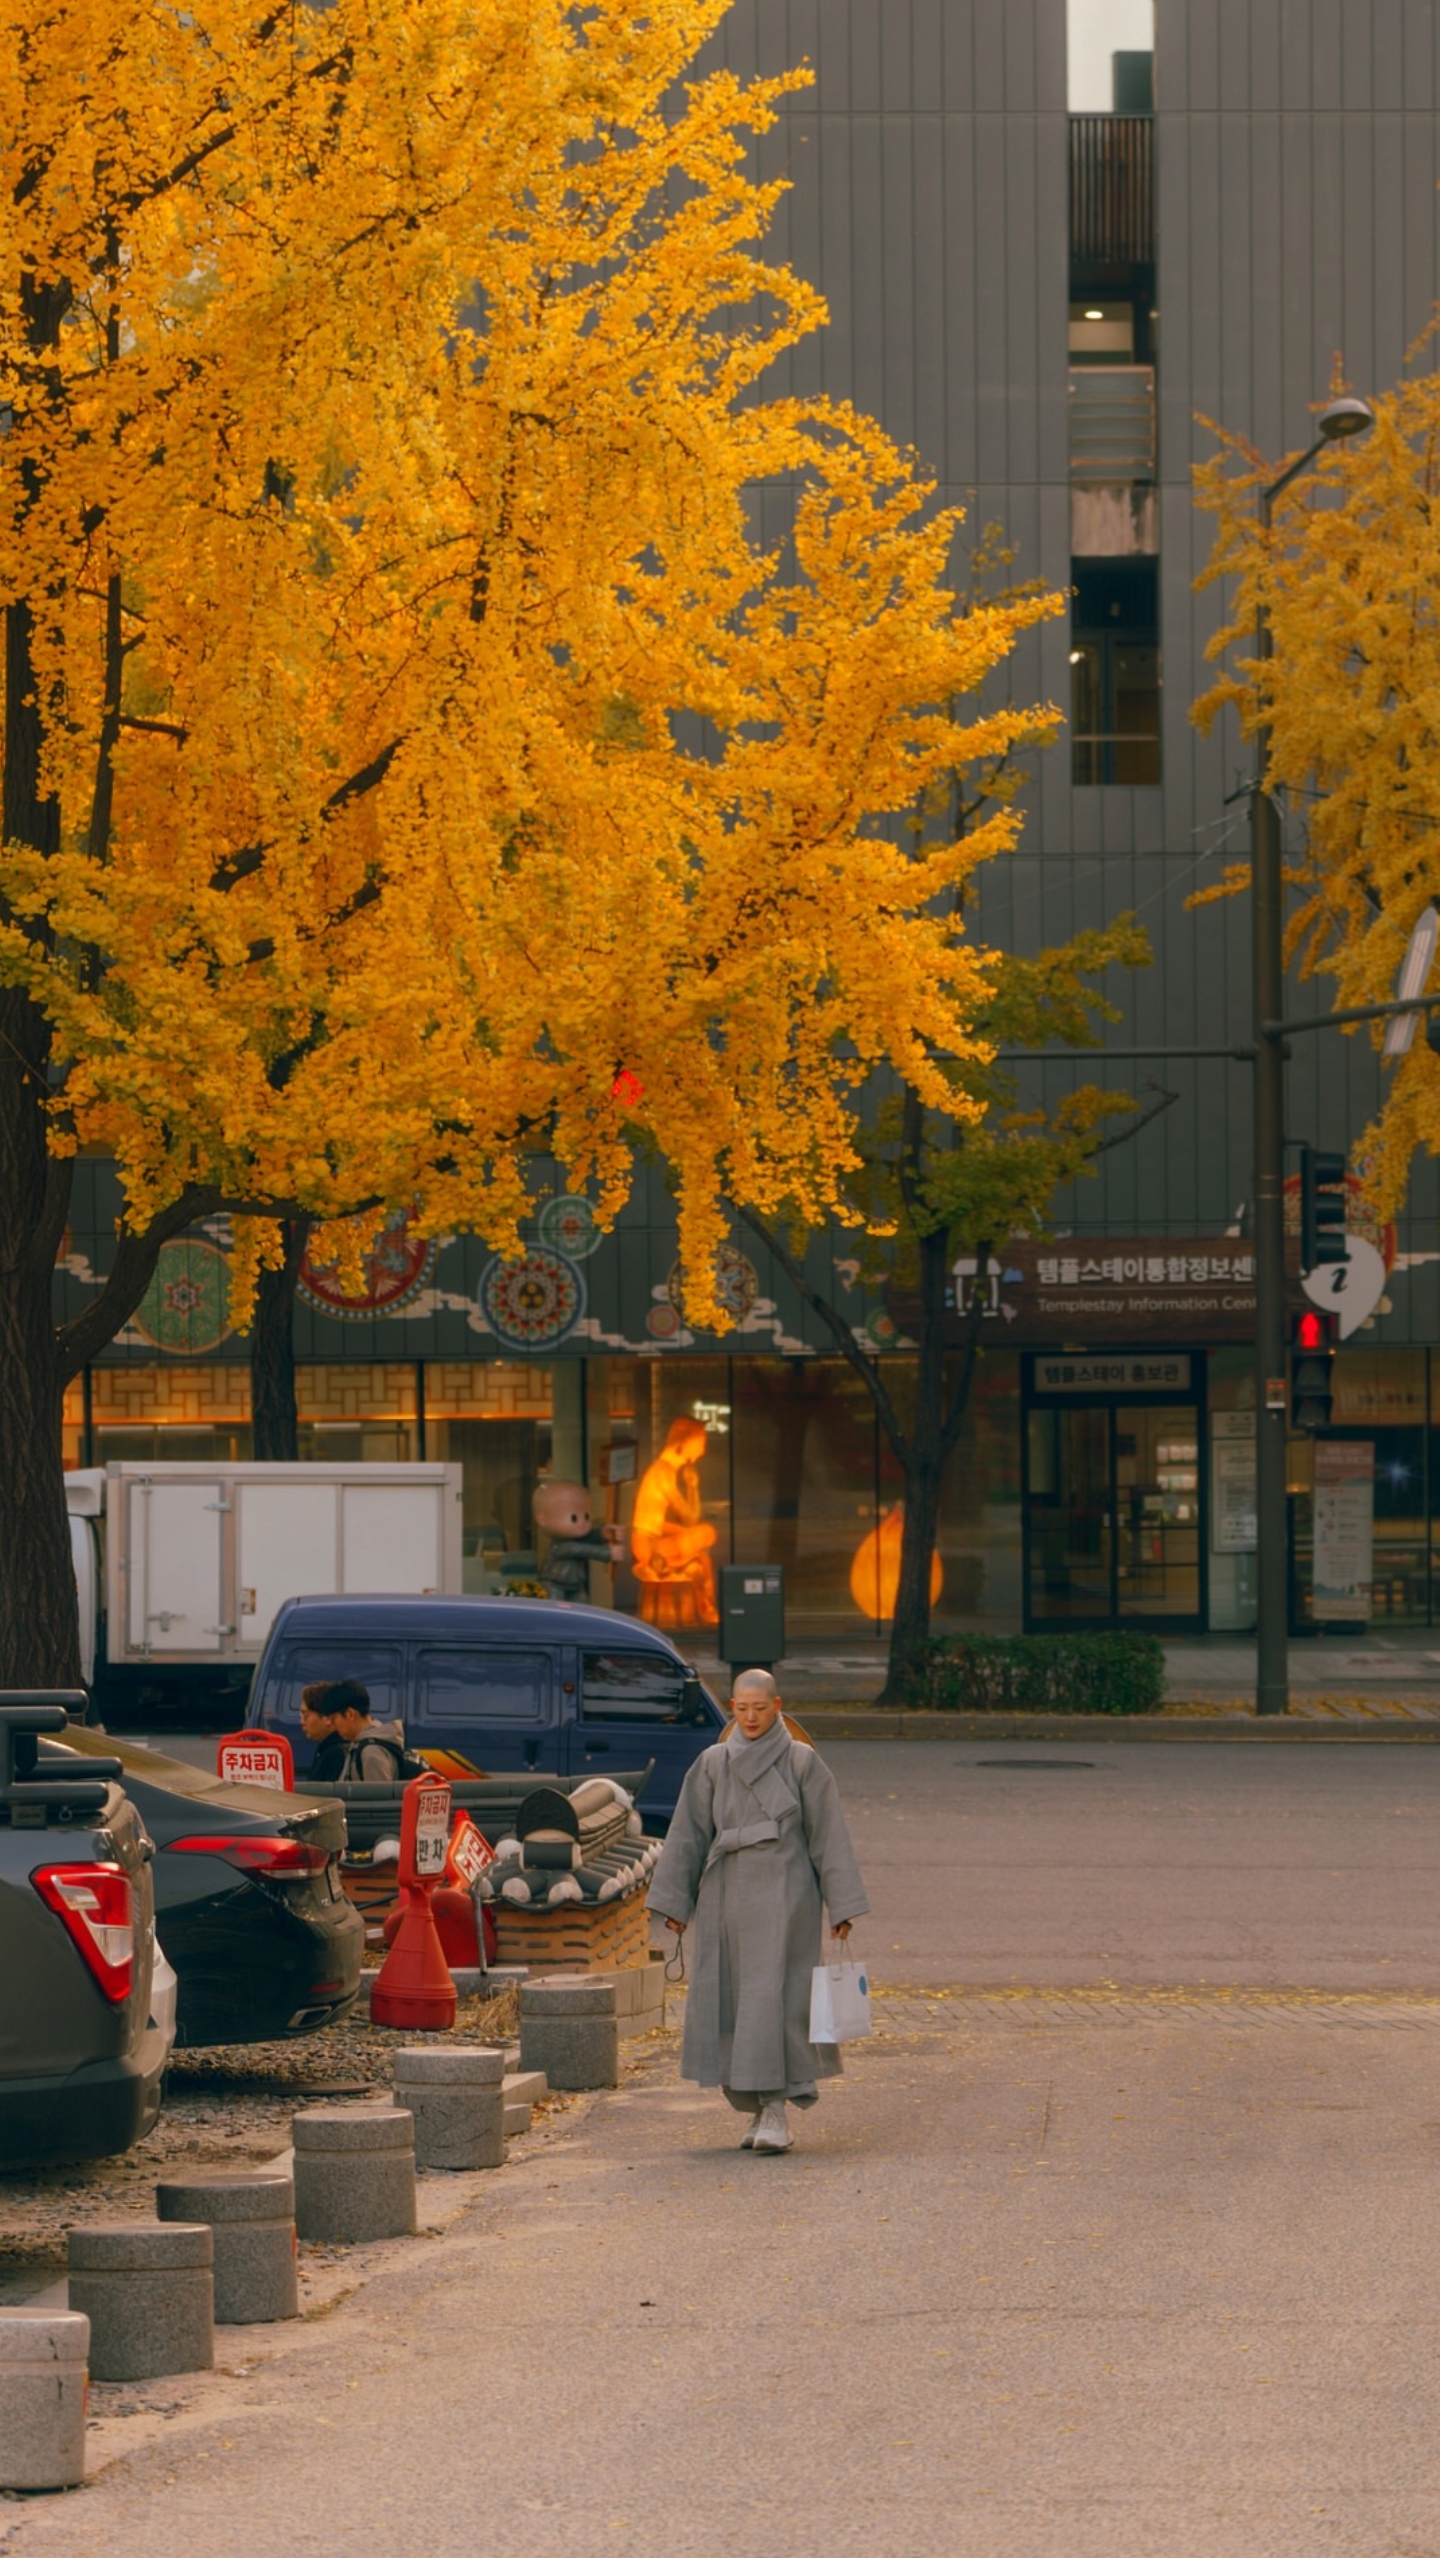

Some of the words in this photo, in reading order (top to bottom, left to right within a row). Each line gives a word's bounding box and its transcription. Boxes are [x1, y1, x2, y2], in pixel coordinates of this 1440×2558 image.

[1036, 1257, 1257, 1284] 템플스테이통합정보센
[1038, 1298, 1124, 1315] Templestay
[1128, 1297, 1218, 1312] Information
[1045, 1365, 1125, 1384] 템플스테이
[1131, 1364, 1179, 1382] 홍보관
[225, 1753, 280, 1771] 주차금지
